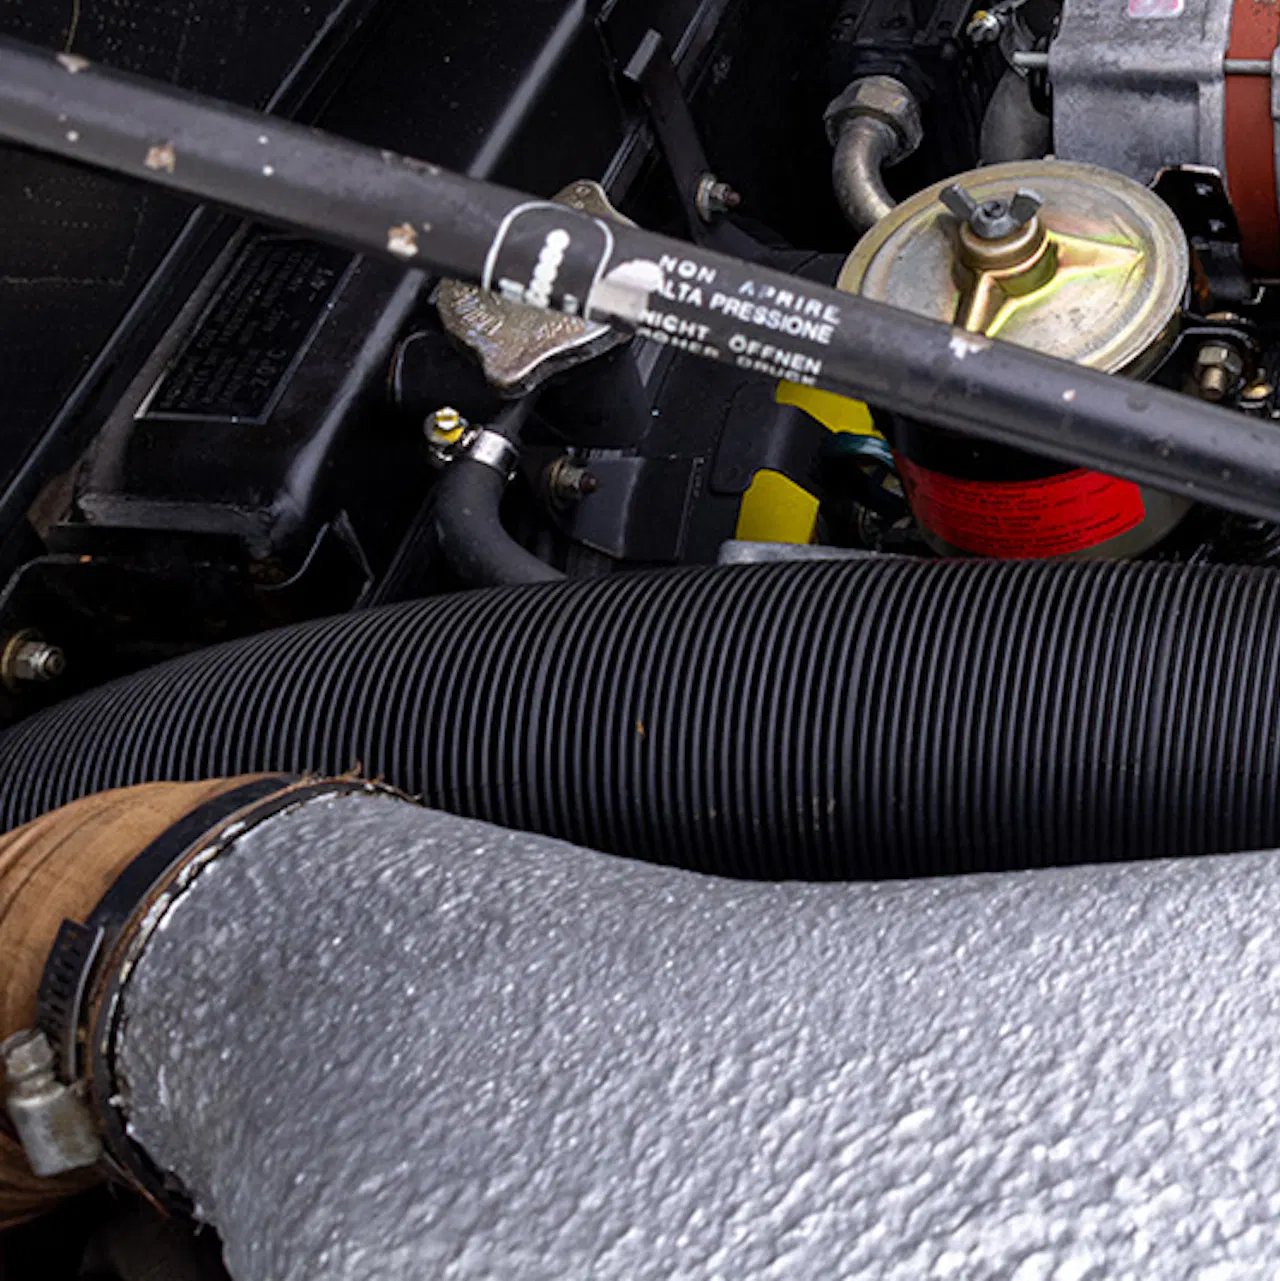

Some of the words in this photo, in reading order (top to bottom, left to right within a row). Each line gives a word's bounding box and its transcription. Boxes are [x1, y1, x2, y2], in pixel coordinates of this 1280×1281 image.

[658, 254, 717, 284] NON
[738, 280, 841, 326] APRIRE
[637, 309, 712, 342] NICHT
[709, 292, 835, 346] PRESSIONE
